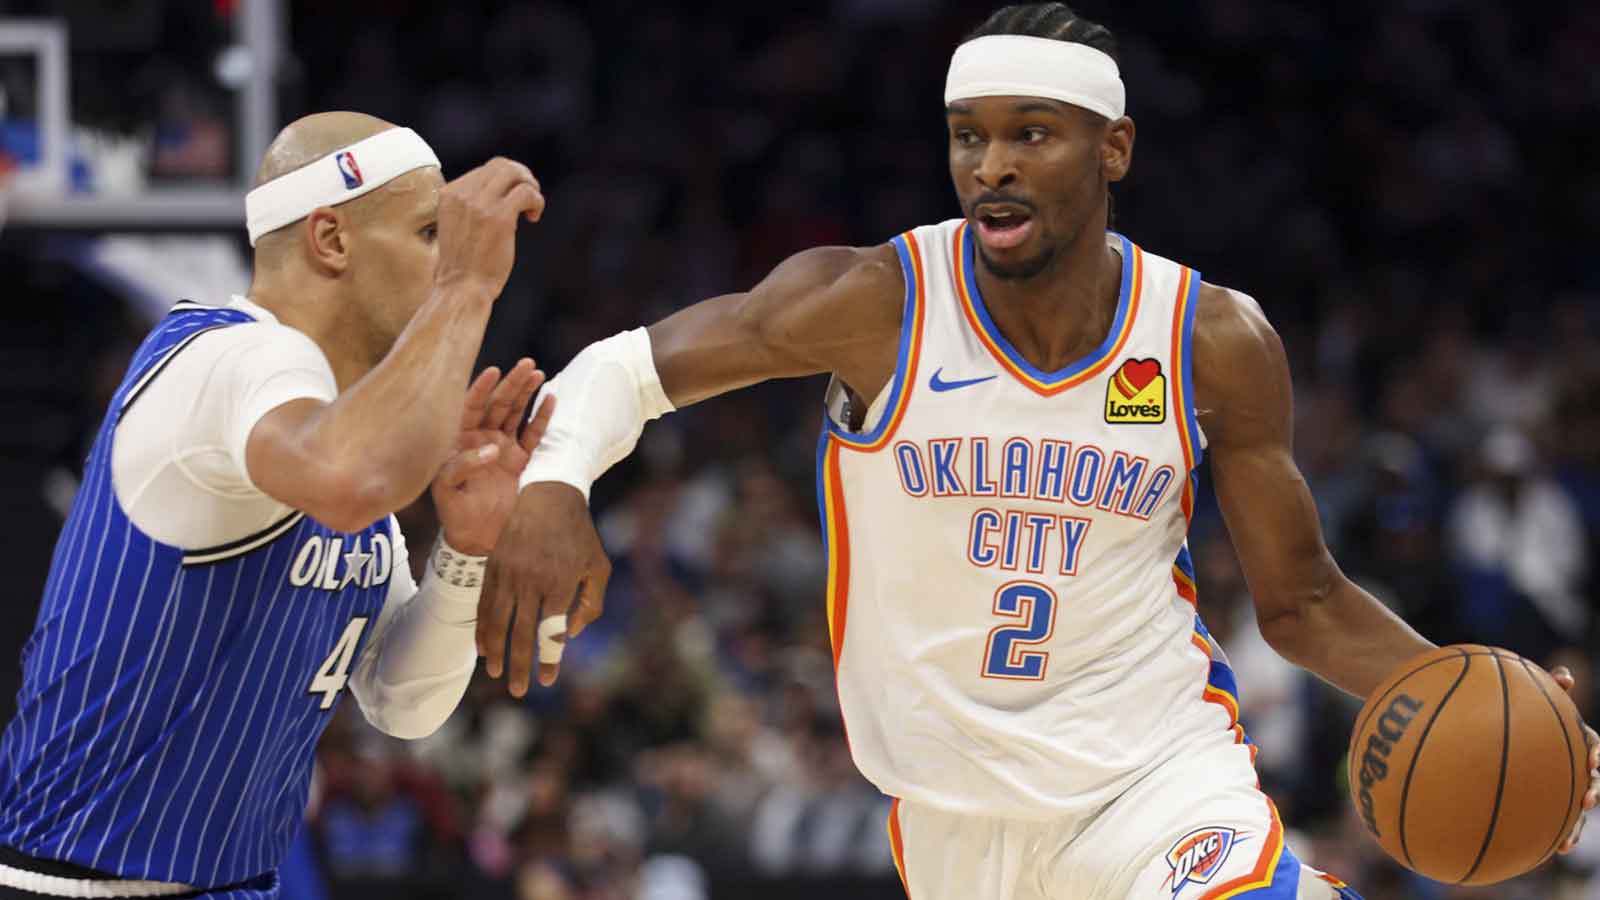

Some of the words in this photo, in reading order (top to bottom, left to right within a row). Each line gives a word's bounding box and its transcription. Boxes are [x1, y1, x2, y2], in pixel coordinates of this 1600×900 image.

[894, 437, 1175, 520] OKLAHOMA
[967, 508, 1093, 576] CITY
[308, 616, 369, 710] 4
[981, 580, 1058, 681] 2
[1171, 833, 1219, 893] OKC
